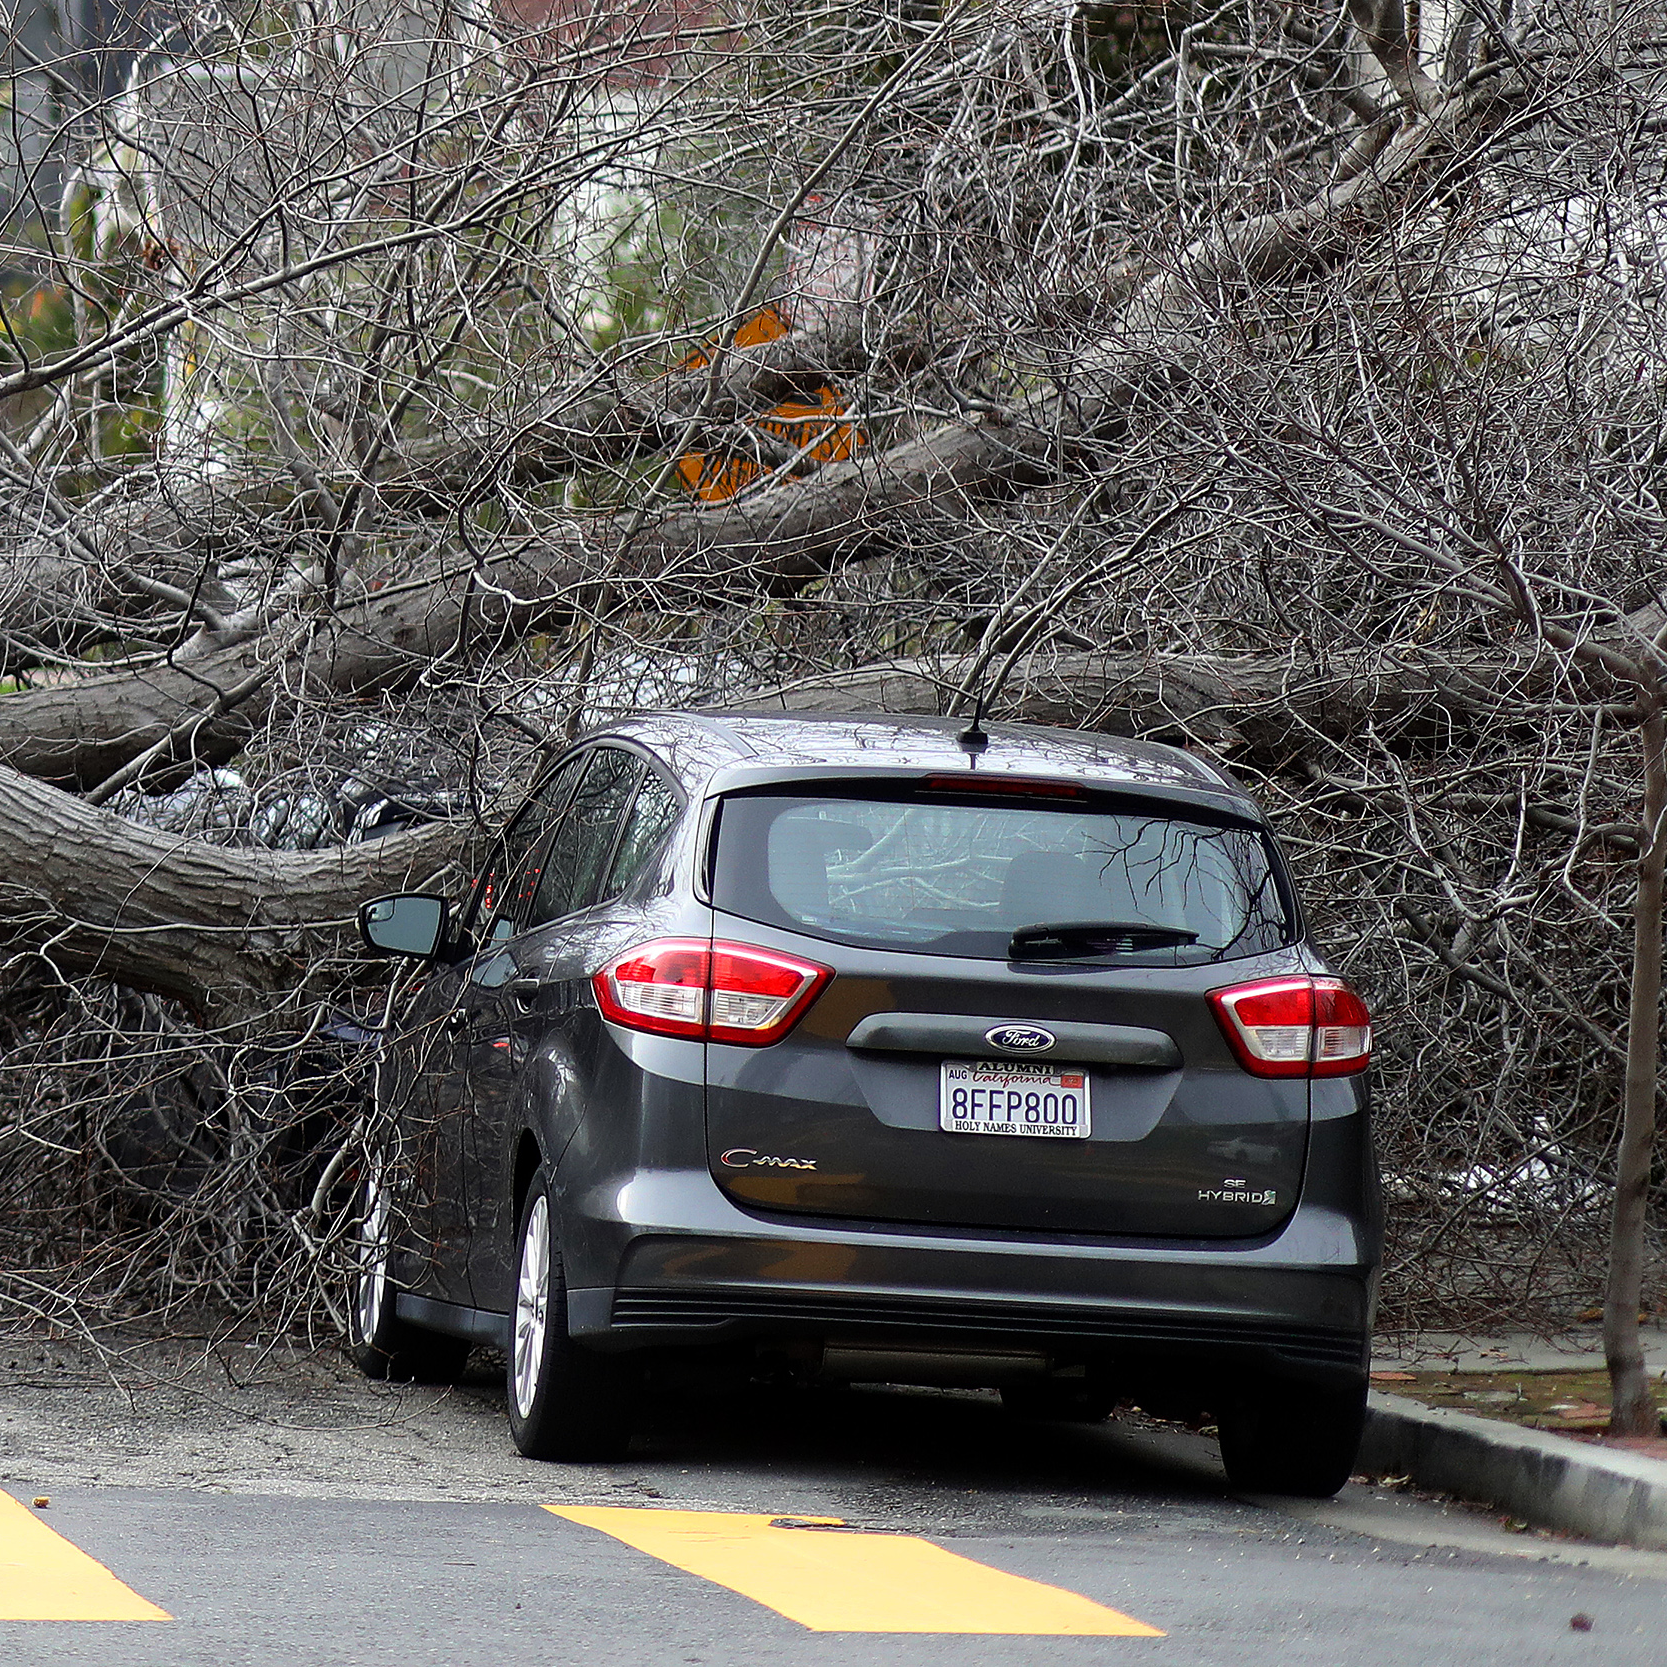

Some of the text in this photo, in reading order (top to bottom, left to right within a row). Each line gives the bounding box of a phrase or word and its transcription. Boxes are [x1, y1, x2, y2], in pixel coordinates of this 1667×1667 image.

[1002, 1029, 1040, 1047] Ford
[948, 1069, 968, 1080] AUG
[978, 1062, 1053, 1074] ALUMNI
[972, 1072, 1051, 1088] California
[952, 1087, 1078, 1125] 8FFP800
[955, 1120, 1078, 1136] HOLY NAMES UNIVERSITY
[1223, 1179, 1246, 1189] SE
[1198, 1189, 1263, 1203] HYBRID
